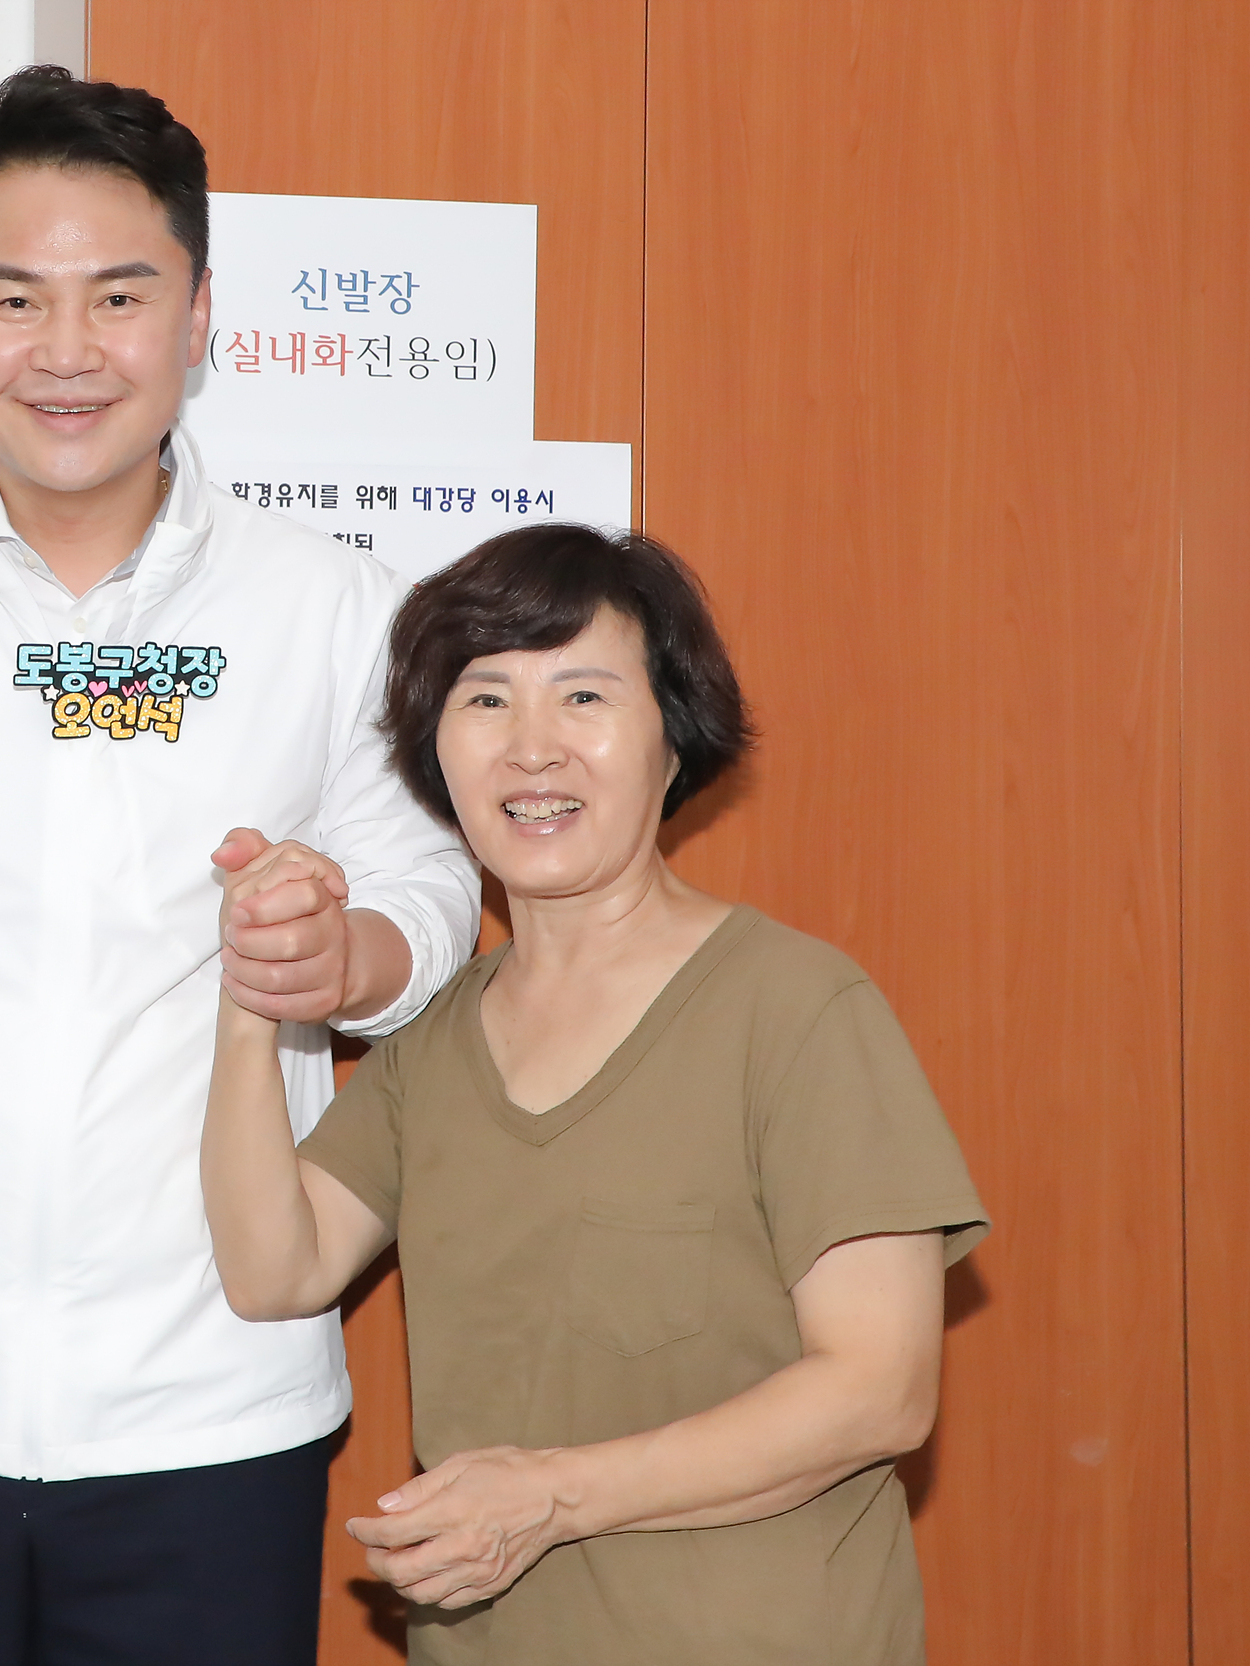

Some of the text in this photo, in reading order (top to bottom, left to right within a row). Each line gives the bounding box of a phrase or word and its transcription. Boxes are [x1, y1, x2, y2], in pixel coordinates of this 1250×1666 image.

[291, 267, 421, 316] 신발장
[209, 328, 498, 383] (실내화전용임)
[355, 484, 399, 511] 위해
[412, 486, 477, 514] 대강당
[491, 488, 556, 514] 이용시
[13, 642, 227, 698] 도봉구청장
[51, 691, 185, 743] 오언석
